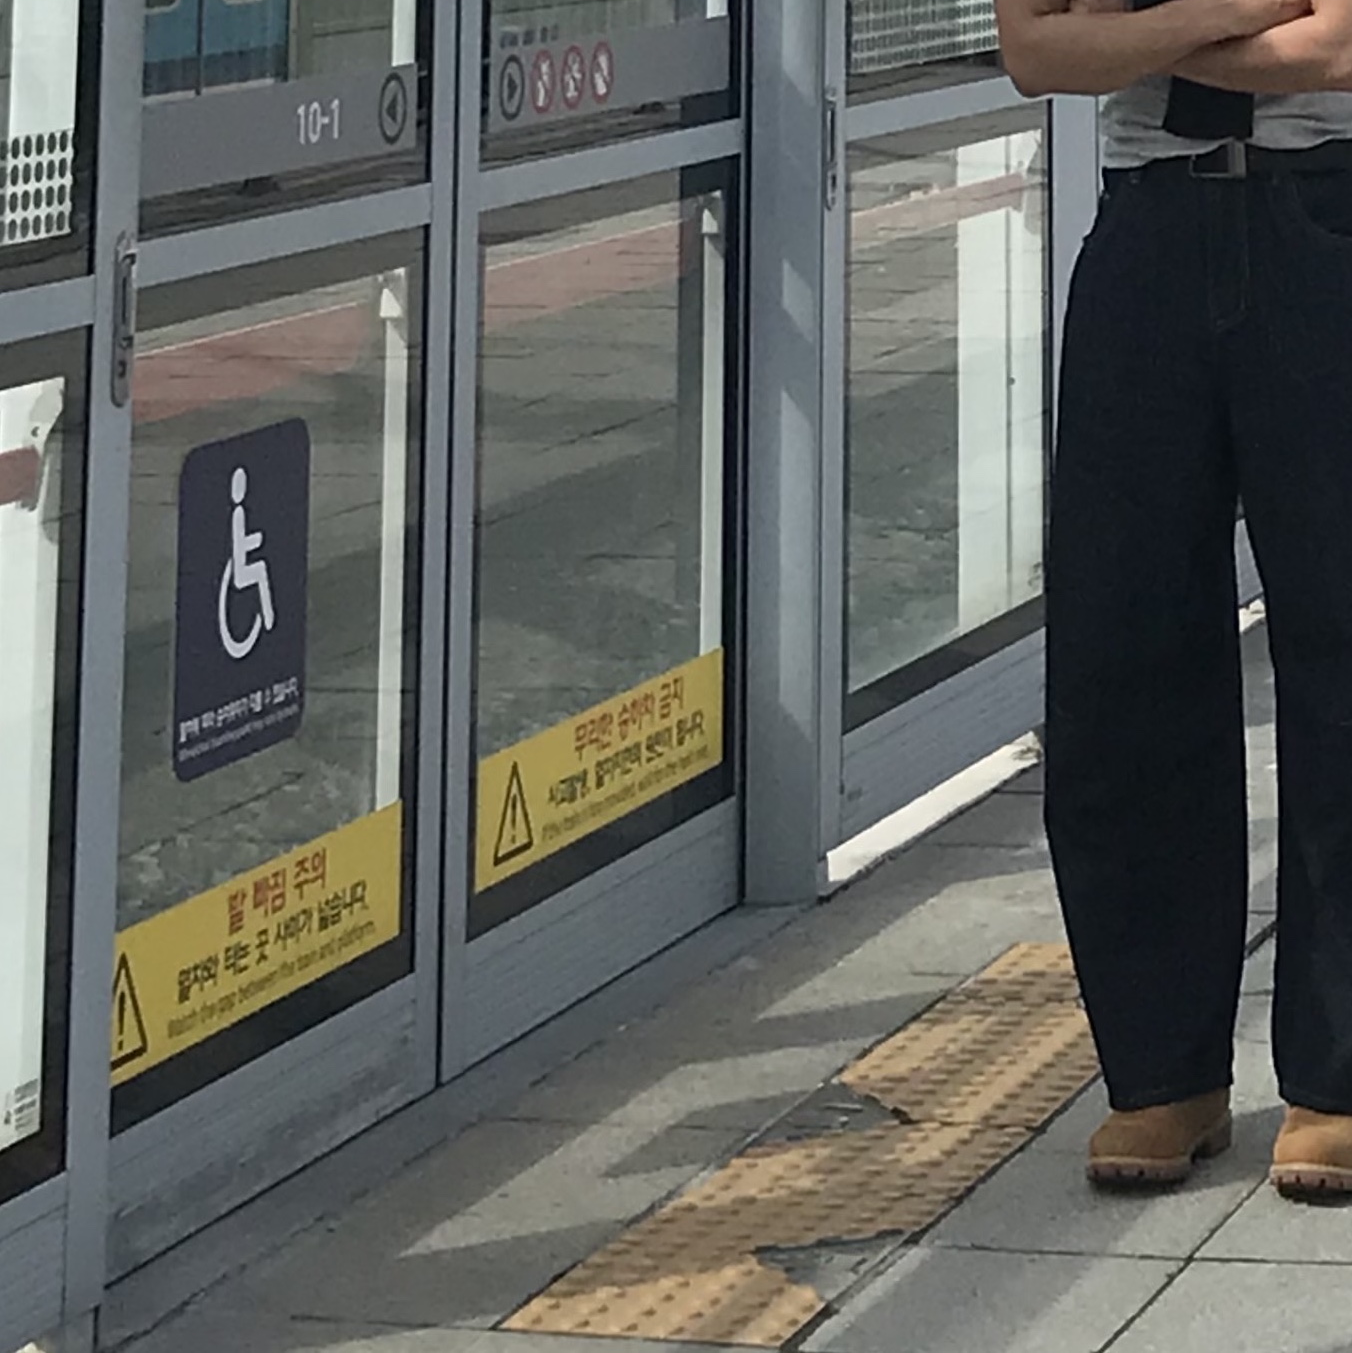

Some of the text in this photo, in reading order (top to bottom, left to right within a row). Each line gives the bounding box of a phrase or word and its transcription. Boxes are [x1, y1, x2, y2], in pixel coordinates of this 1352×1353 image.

[296, 98, 340, 145] 10-1
[575, 713, 614, 761] 무리한
[659, 675, 684, 720] 금지
[227, 848, 327, 936] 발 빠짐 주의
[177, 953, 219, 1004] 열차와
[255, 928, 269, 965] 곳
[273, 908, 313, 951] 사이가
[317, 879, 369, 933] 넓습니다
